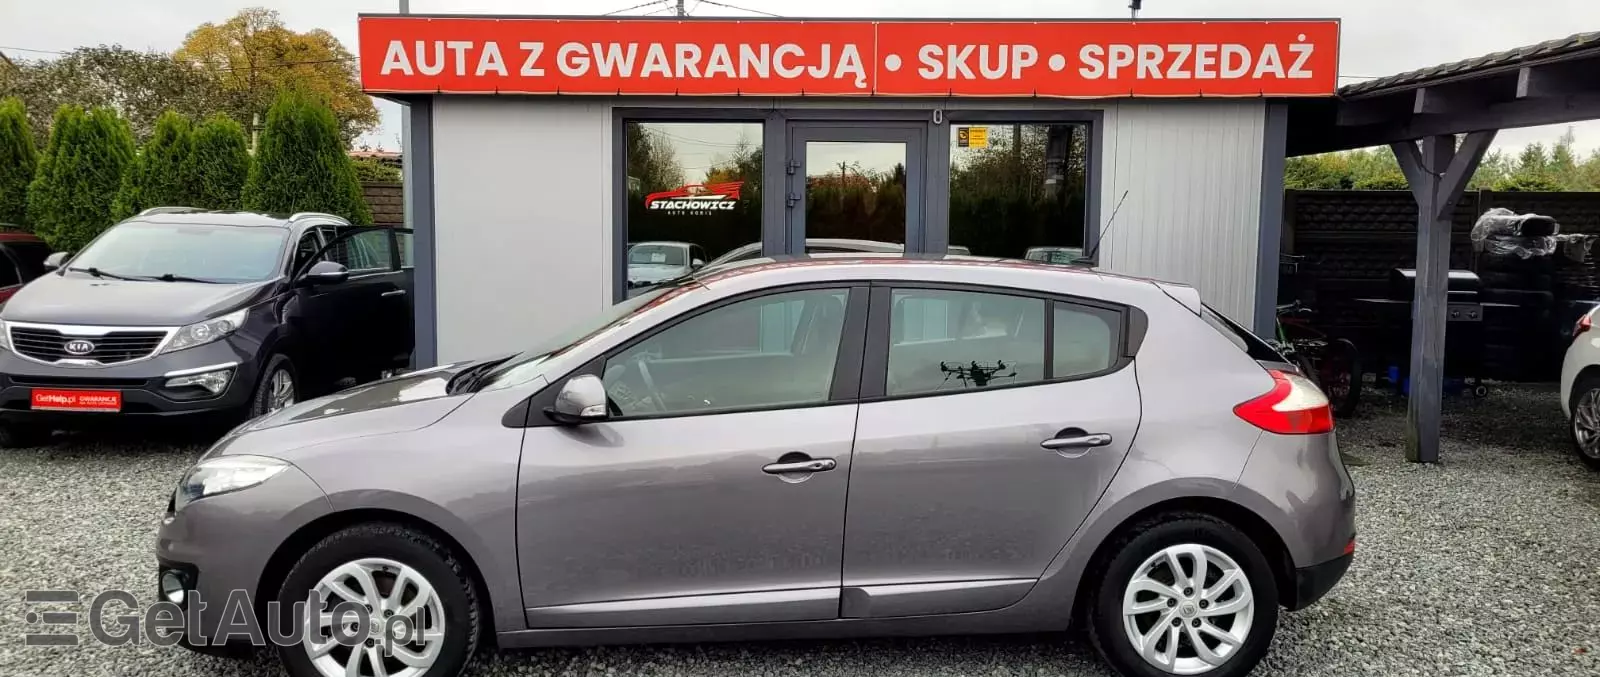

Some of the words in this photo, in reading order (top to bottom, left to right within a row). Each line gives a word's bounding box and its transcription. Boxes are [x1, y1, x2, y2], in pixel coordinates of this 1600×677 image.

[380, 41, 509, 77] AUTA
[519, 42, 545, 77] Z
[556, 42, 868, 89] GWARANCJĄ
[918, 44, 1039, 80] SKUP
[1079, 34, 1314, 80] SPRZEDAŻ
[650, 201, 736, 210] STACHOWICZ
